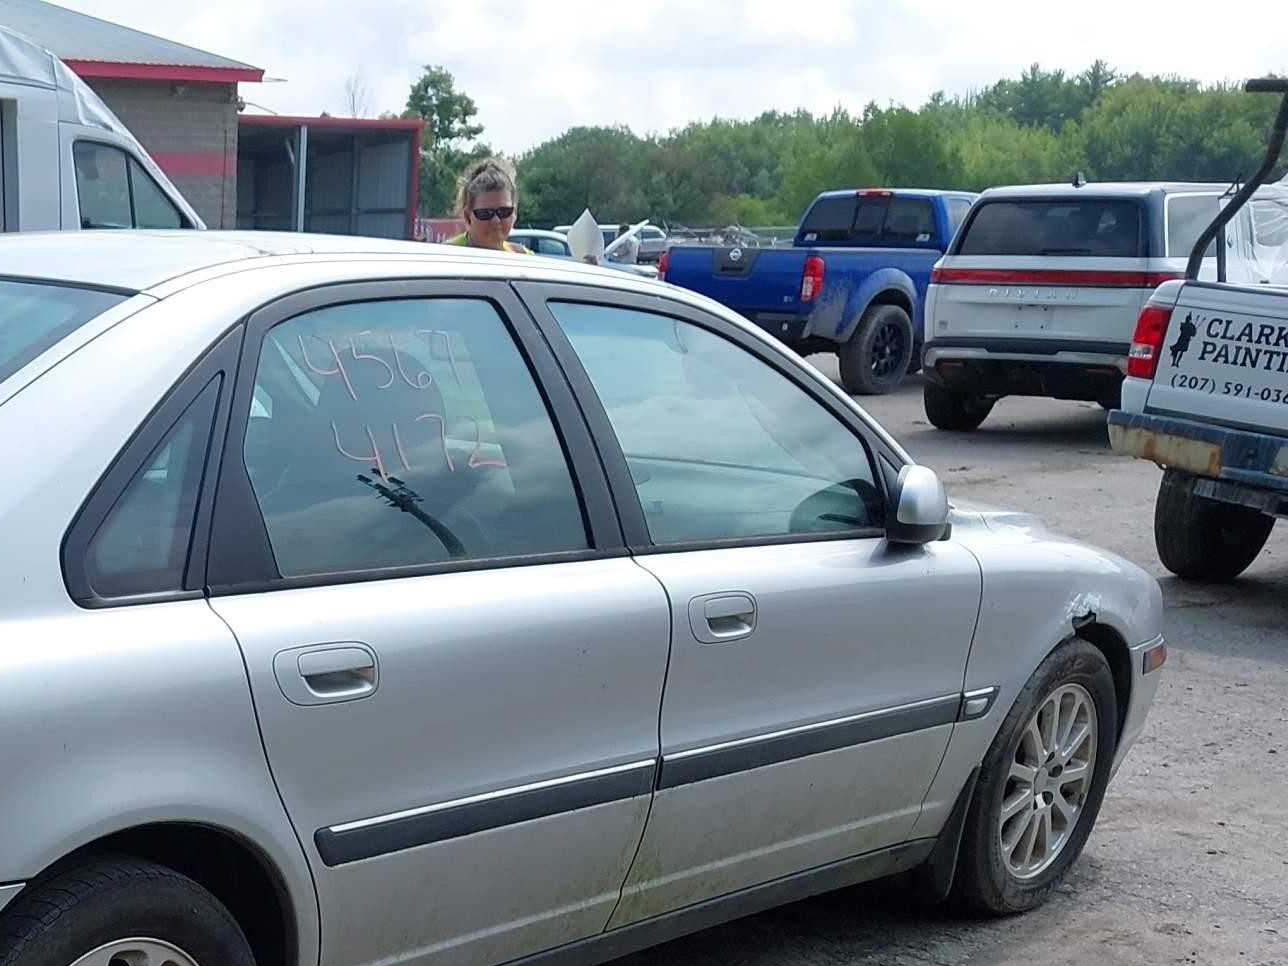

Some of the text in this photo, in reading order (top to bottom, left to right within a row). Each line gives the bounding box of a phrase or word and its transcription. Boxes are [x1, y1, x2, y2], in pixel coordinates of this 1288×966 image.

[988, 288, 1078, 300] RIVIAN
[297, 330, 464, 401] 4567
[1198, 341, 1288, 374] PAINTI
[1171, 373, 1216, 394] (207)
[331, 413, 508, 484] 4172
